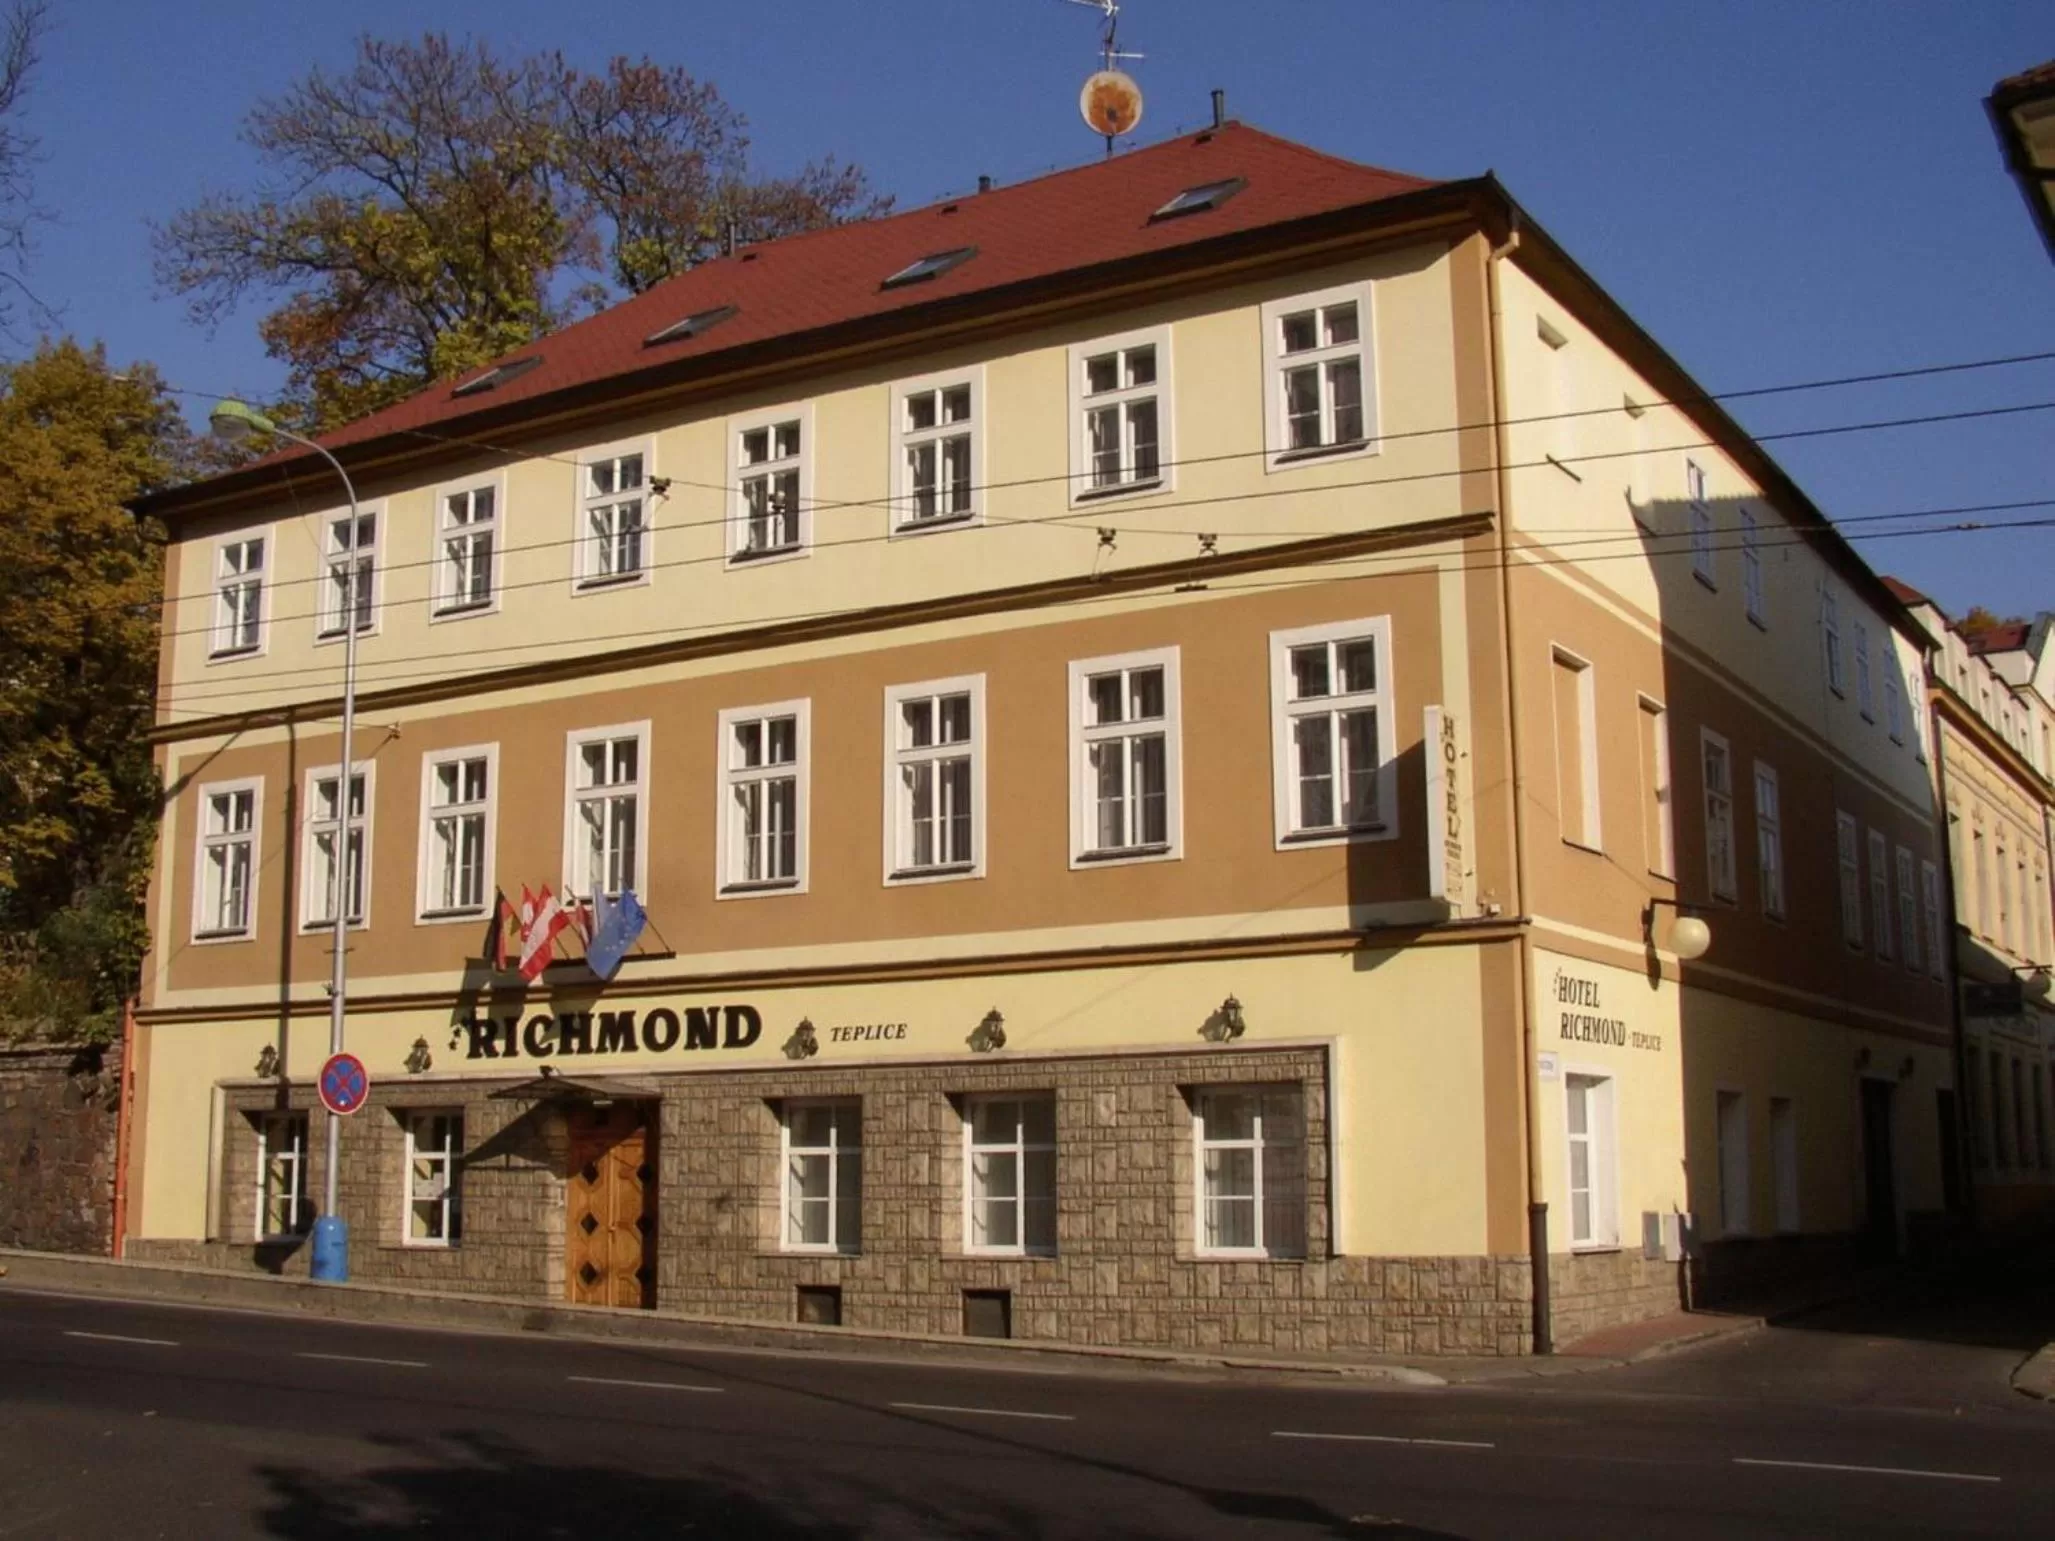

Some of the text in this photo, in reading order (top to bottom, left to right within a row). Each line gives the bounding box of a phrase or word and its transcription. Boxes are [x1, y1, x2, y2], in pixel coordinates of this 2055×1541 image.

[1443, 714, 1458, 839] HOTEL
[1557, 975, 1600, 1008] HOTEL
[466, 1006, 763, 1059] RICHMOND
[830, 1023, 908, 1042] TEPLICE
[1560, 1012, 1626, 1046] RICHMOND
